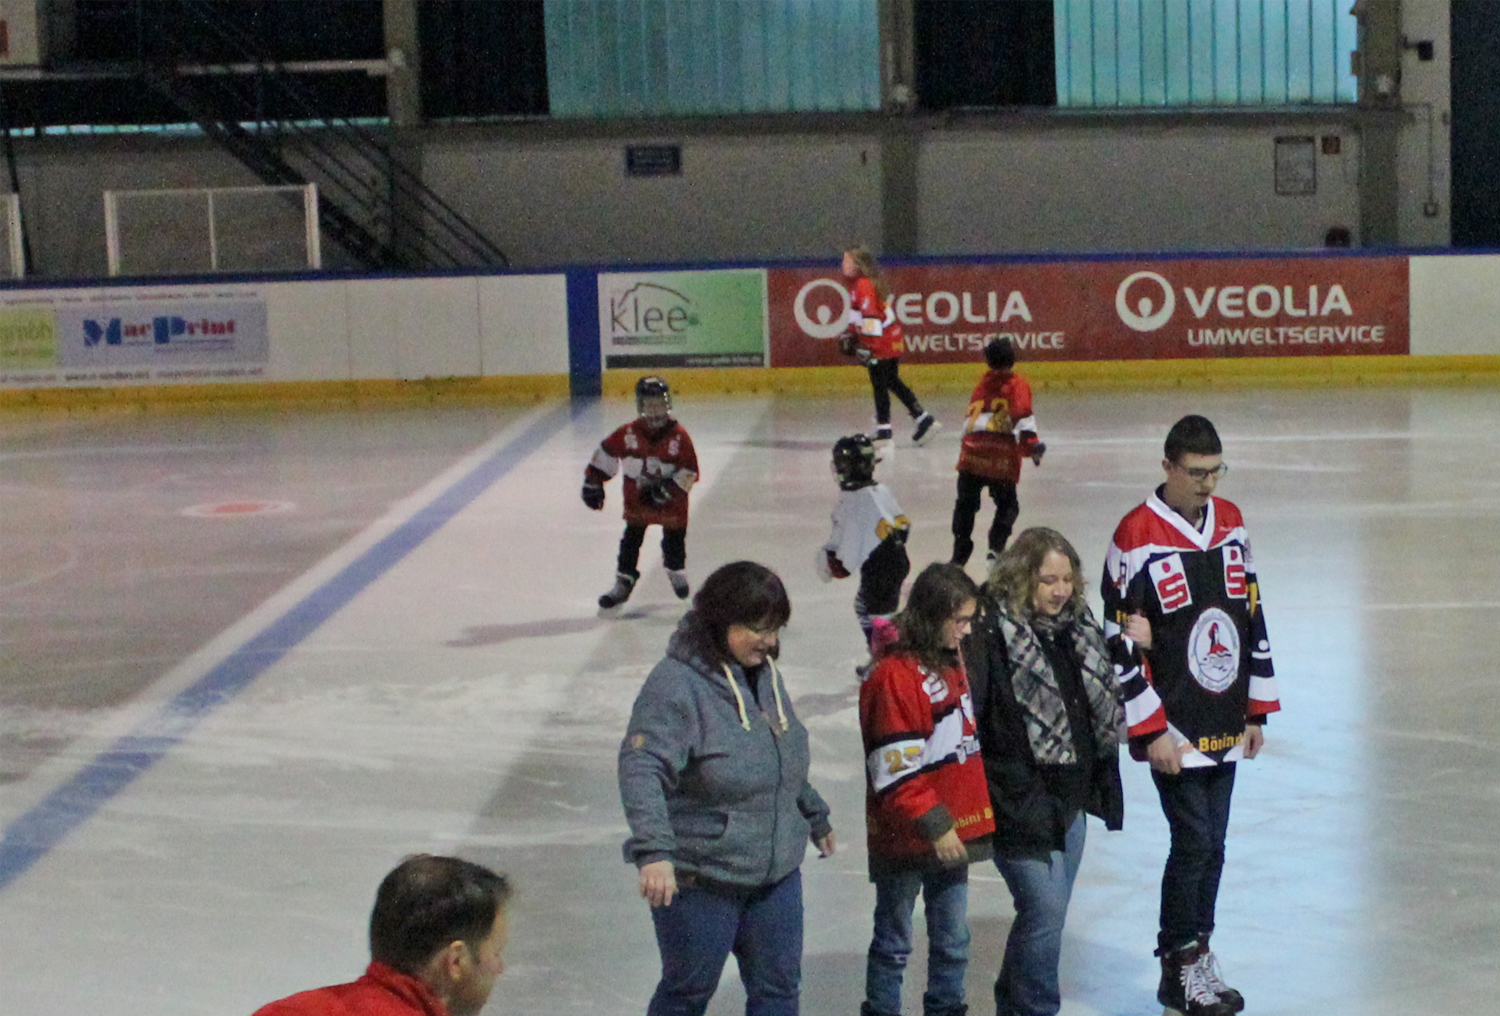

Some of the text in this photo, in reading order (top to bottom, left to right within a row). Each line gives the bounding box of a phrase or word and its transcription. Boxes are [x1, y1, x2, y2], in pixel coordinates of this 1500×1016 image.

[886, 289, 1033, 324] EOLIA
[1183, 284, 1353, 318] VEOLIA
[904, 330, 1065, 353] WELTSEVICE
[1187, 325, 1386, 347] UMWELTSERVICE
